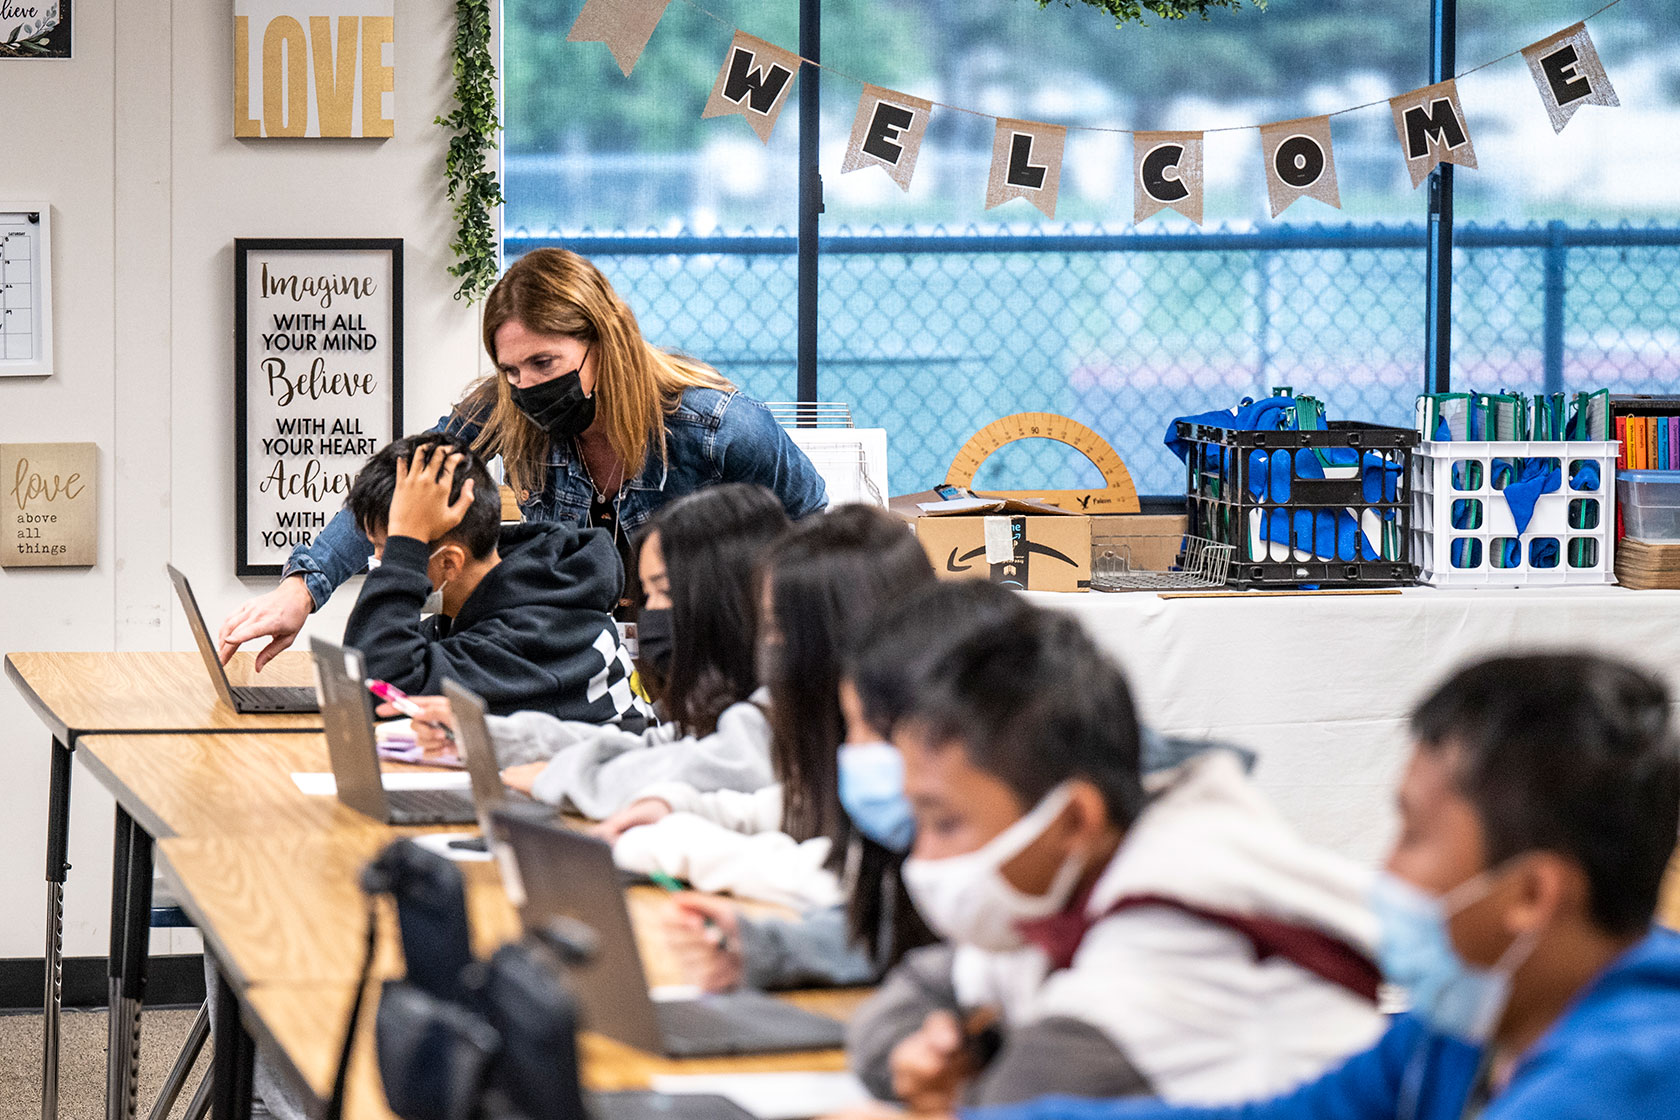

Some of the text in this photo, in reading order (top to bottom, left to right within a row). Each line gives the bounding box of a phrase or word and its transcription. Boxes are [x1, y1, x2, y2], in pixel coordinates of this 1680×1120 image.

[0, 0, 38, 20] lieve
[234, 15, 394, 138] LOVE
[261, 262, 377, 308] Imagine
[273, 314, 366, 331] WITH ALL
[262, 334, 377, 351] YOUR MIND
[261, 357, 377, 406] Believe
[276, 418, 363, 435] WITH ALL
[262, 438, 377, 455] YOUR HEART
[10, 457, 86, 510] love
[259, 459, 360, 503] Achiev
[17, 513, 58, 524] above
[276, 512, 325, 528] WITH
[17, 527, 41, 539] all
[261, 531, 312, 547] YOUR
[17, 543, 67, 556] things
